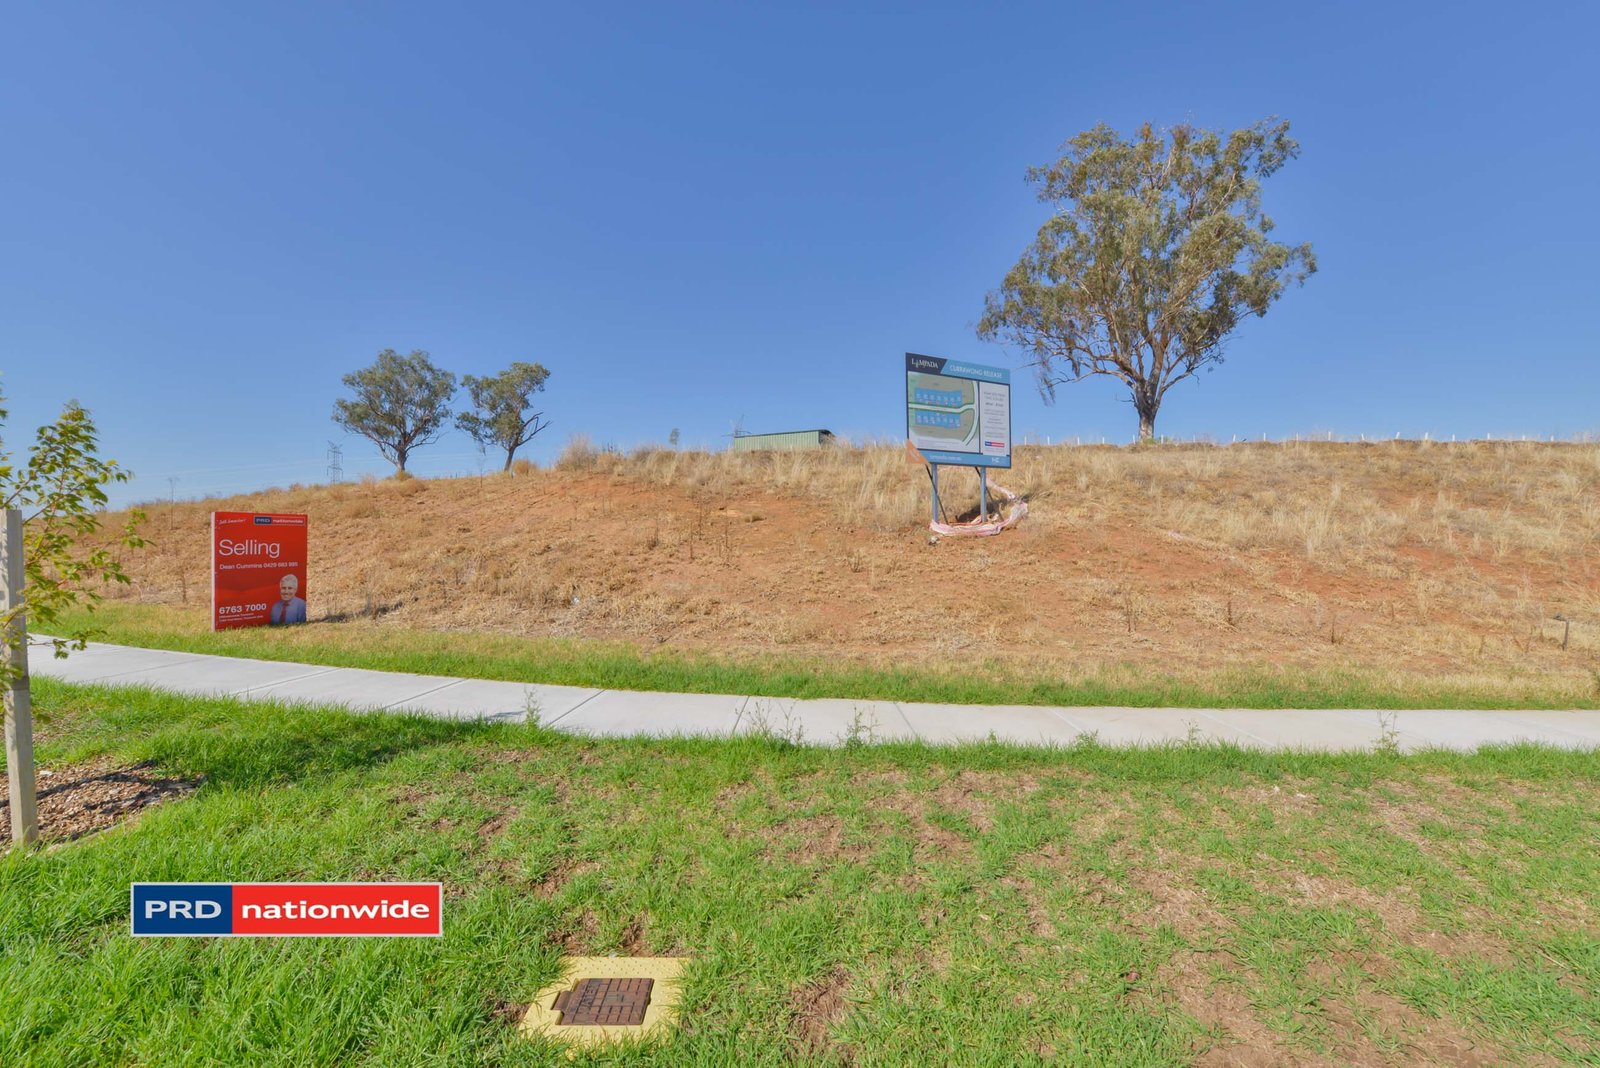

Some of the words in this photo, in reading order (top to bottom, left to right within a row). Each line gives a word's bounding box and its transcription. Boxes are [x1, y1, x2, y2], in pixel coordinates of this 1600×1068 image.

[218, 539, 280, 558] Selling
[218, 604, 243, 615] 6763
[245, 603, 267, 612] 7000
